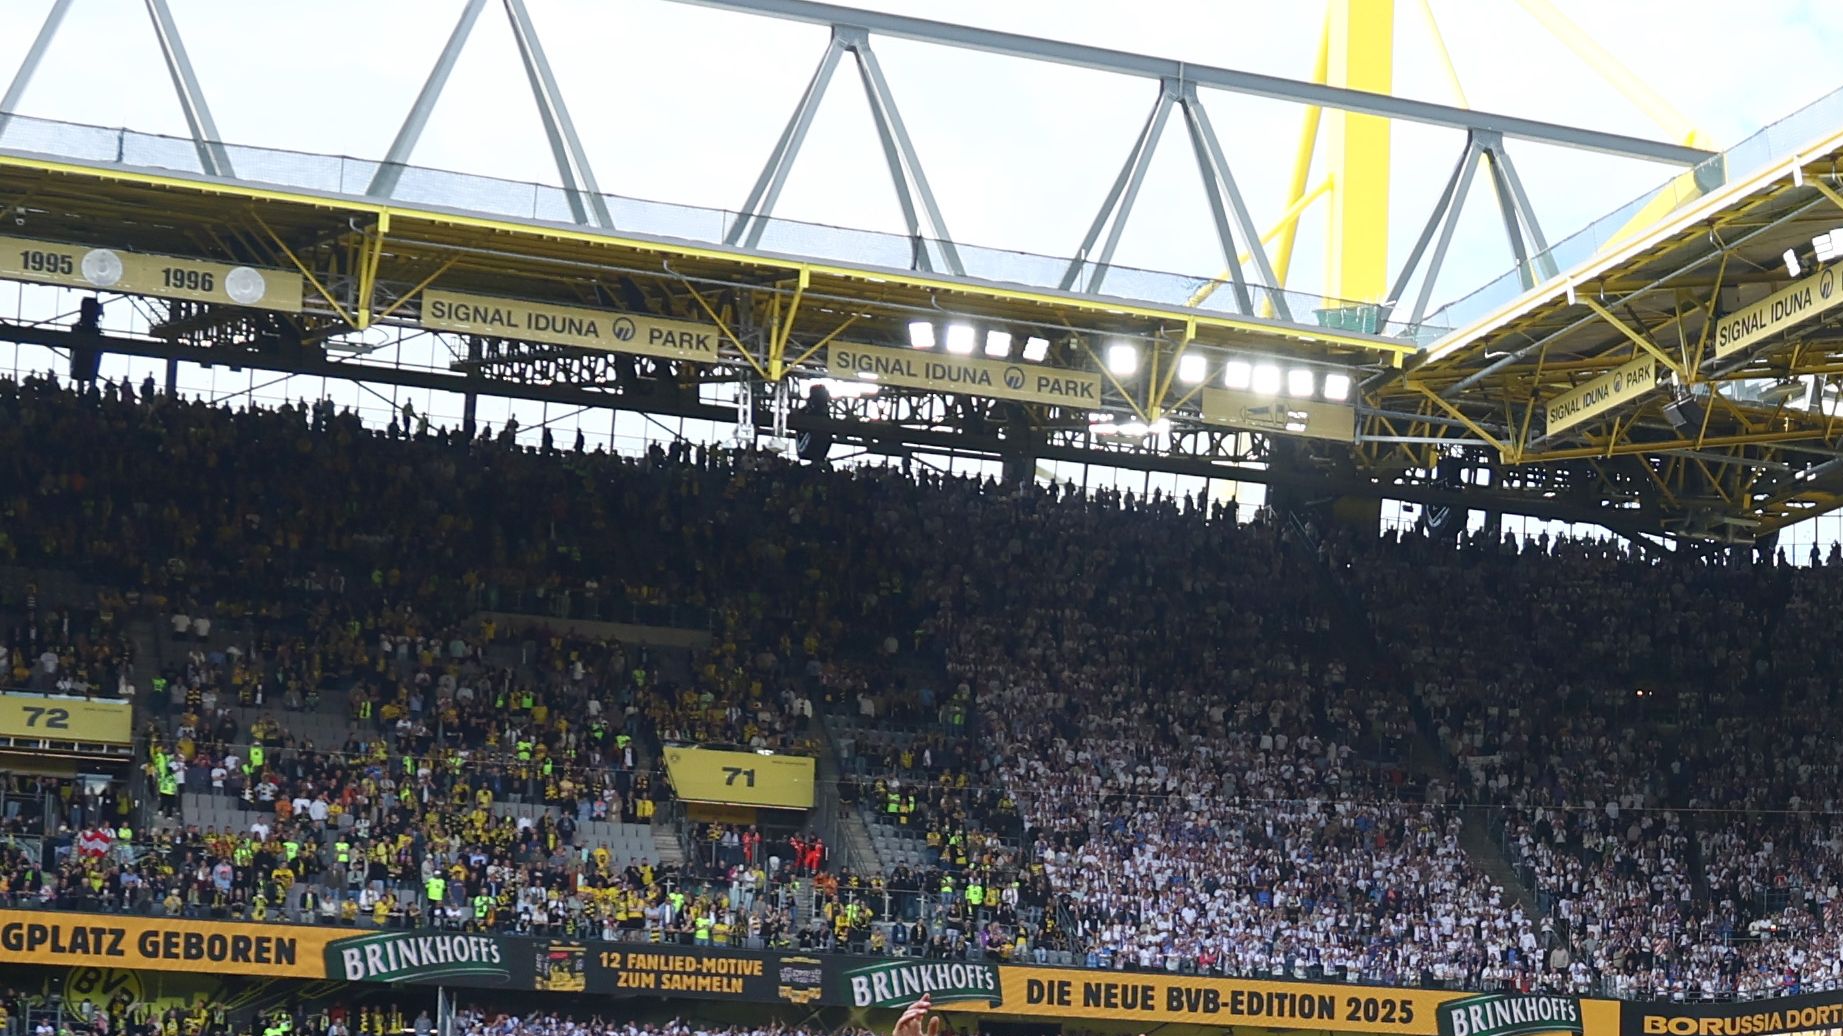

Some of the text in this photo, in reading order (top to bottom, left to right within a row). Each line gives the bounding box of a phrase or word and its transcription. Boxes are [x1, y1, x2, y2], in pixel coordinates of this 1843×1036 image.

[20, 250, 73, 275] 1995
[161, 267, 214, 292] 1996
[431, 301, 711, 352] SIGNAL IDUNA PARK
[1719, 310, 1767, 347] SIGNAL
[1771, 287, 1812, 323] IDUNA
[837, 351, 1094, 399] SIGNAL IDUNA PARK
[1550, 364, 1651, 424] SIGNAL IDUNA PARK
[22, 706, 69, 729] 72
[722, 766, 755, 787] 71
[1, 922, 298, 965] GPLATZ GEBOREN
[342, 935, 500, 981] BRINKHOFF's
[599, 951, 621, 969] 12
[627, 953, 763, 976] FANLIED-MOTIVE
[617, 971, 744, 993] ZUM SAMMELN
[851, 963, 995, 1007] BRINKHOFF's
[1027, 979, 1414, 1024] DIE NEUE BVB-EDITION 2025
[1643, 1011, 1782, 1036] BORUSSIA
